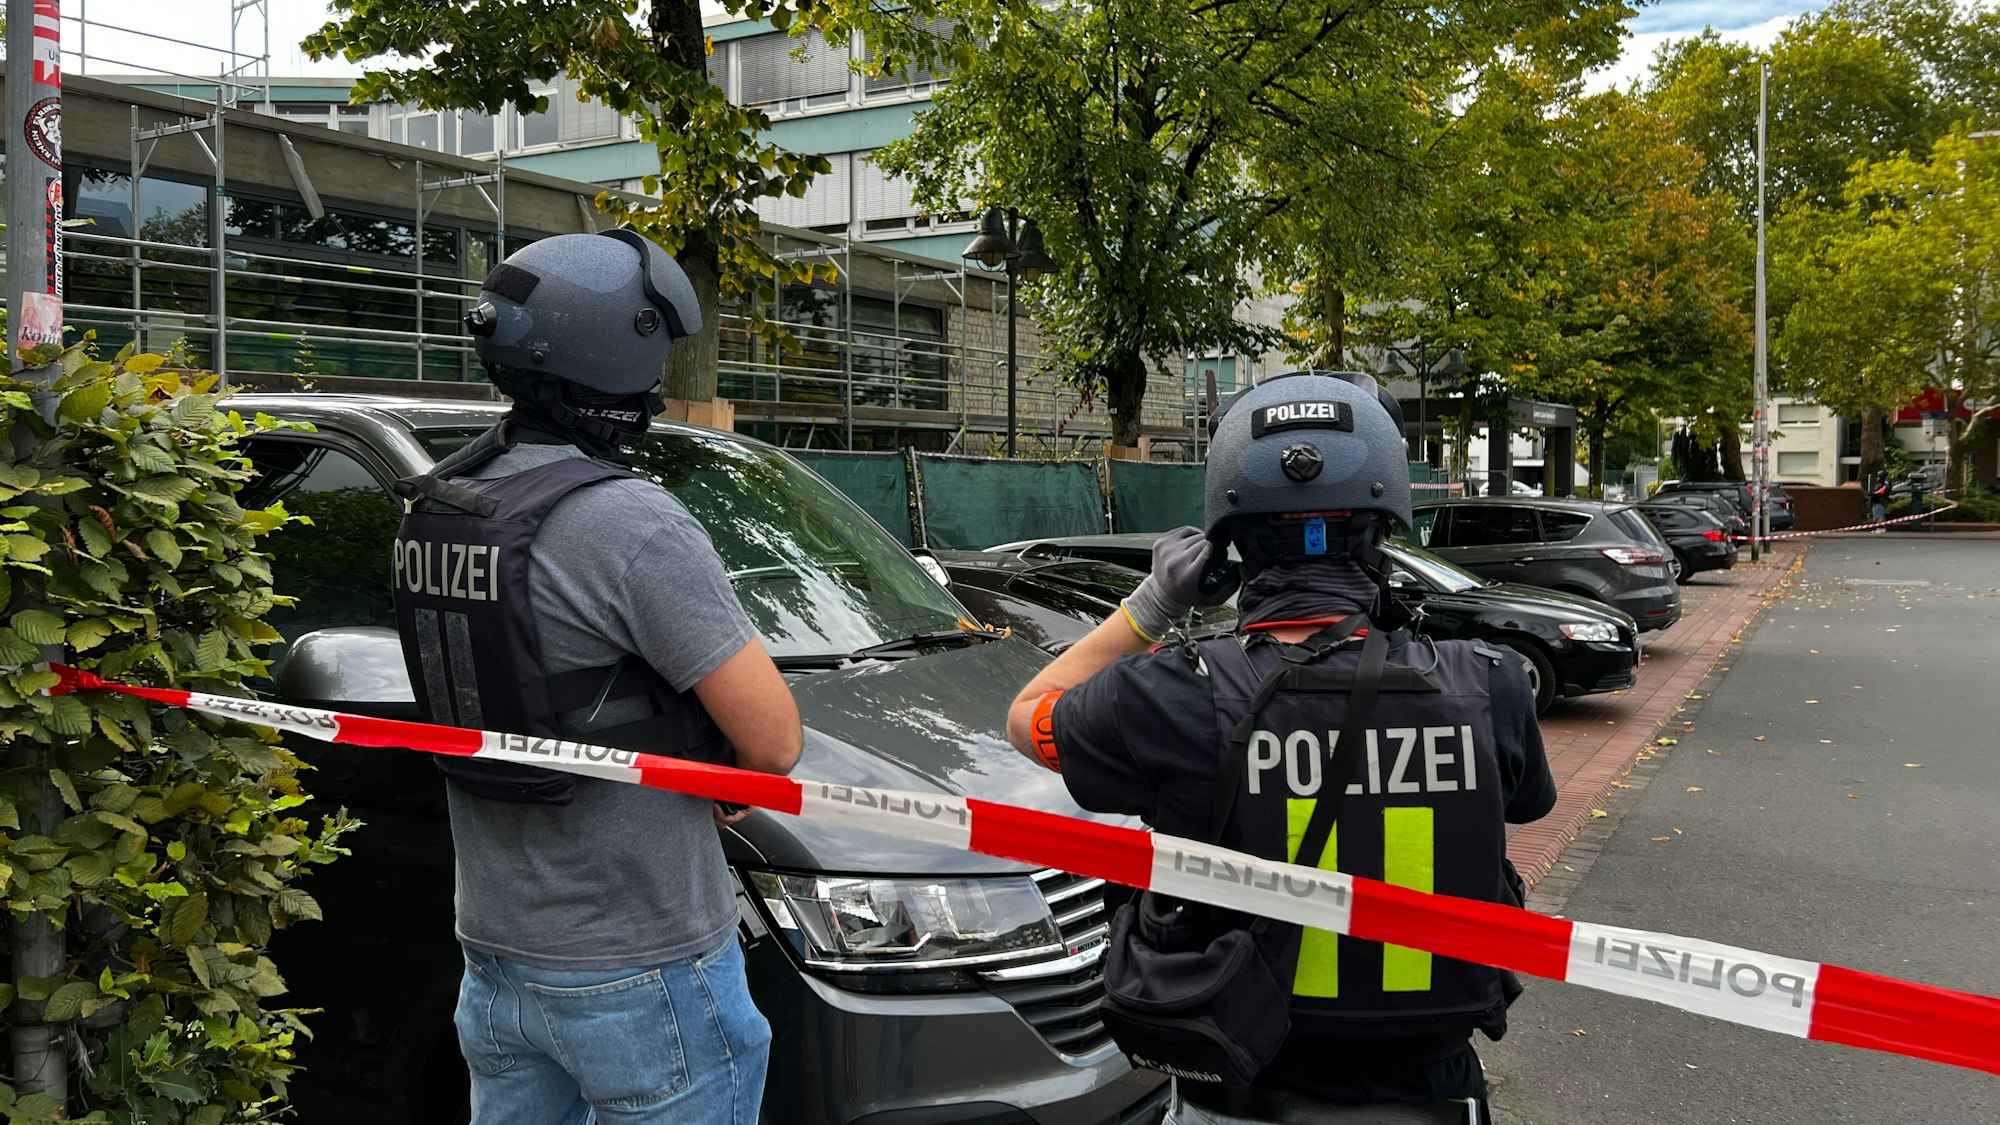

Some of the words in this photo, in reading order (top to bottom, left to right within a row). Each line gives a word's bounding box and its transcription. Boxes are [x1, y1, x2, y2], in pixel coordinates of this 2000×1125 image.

[1266, 403, 1335, 424] POLIZEI
[394, 538, 500, 602] POLIZEI
[1146, 1059, 1222, 1082] Columbia
